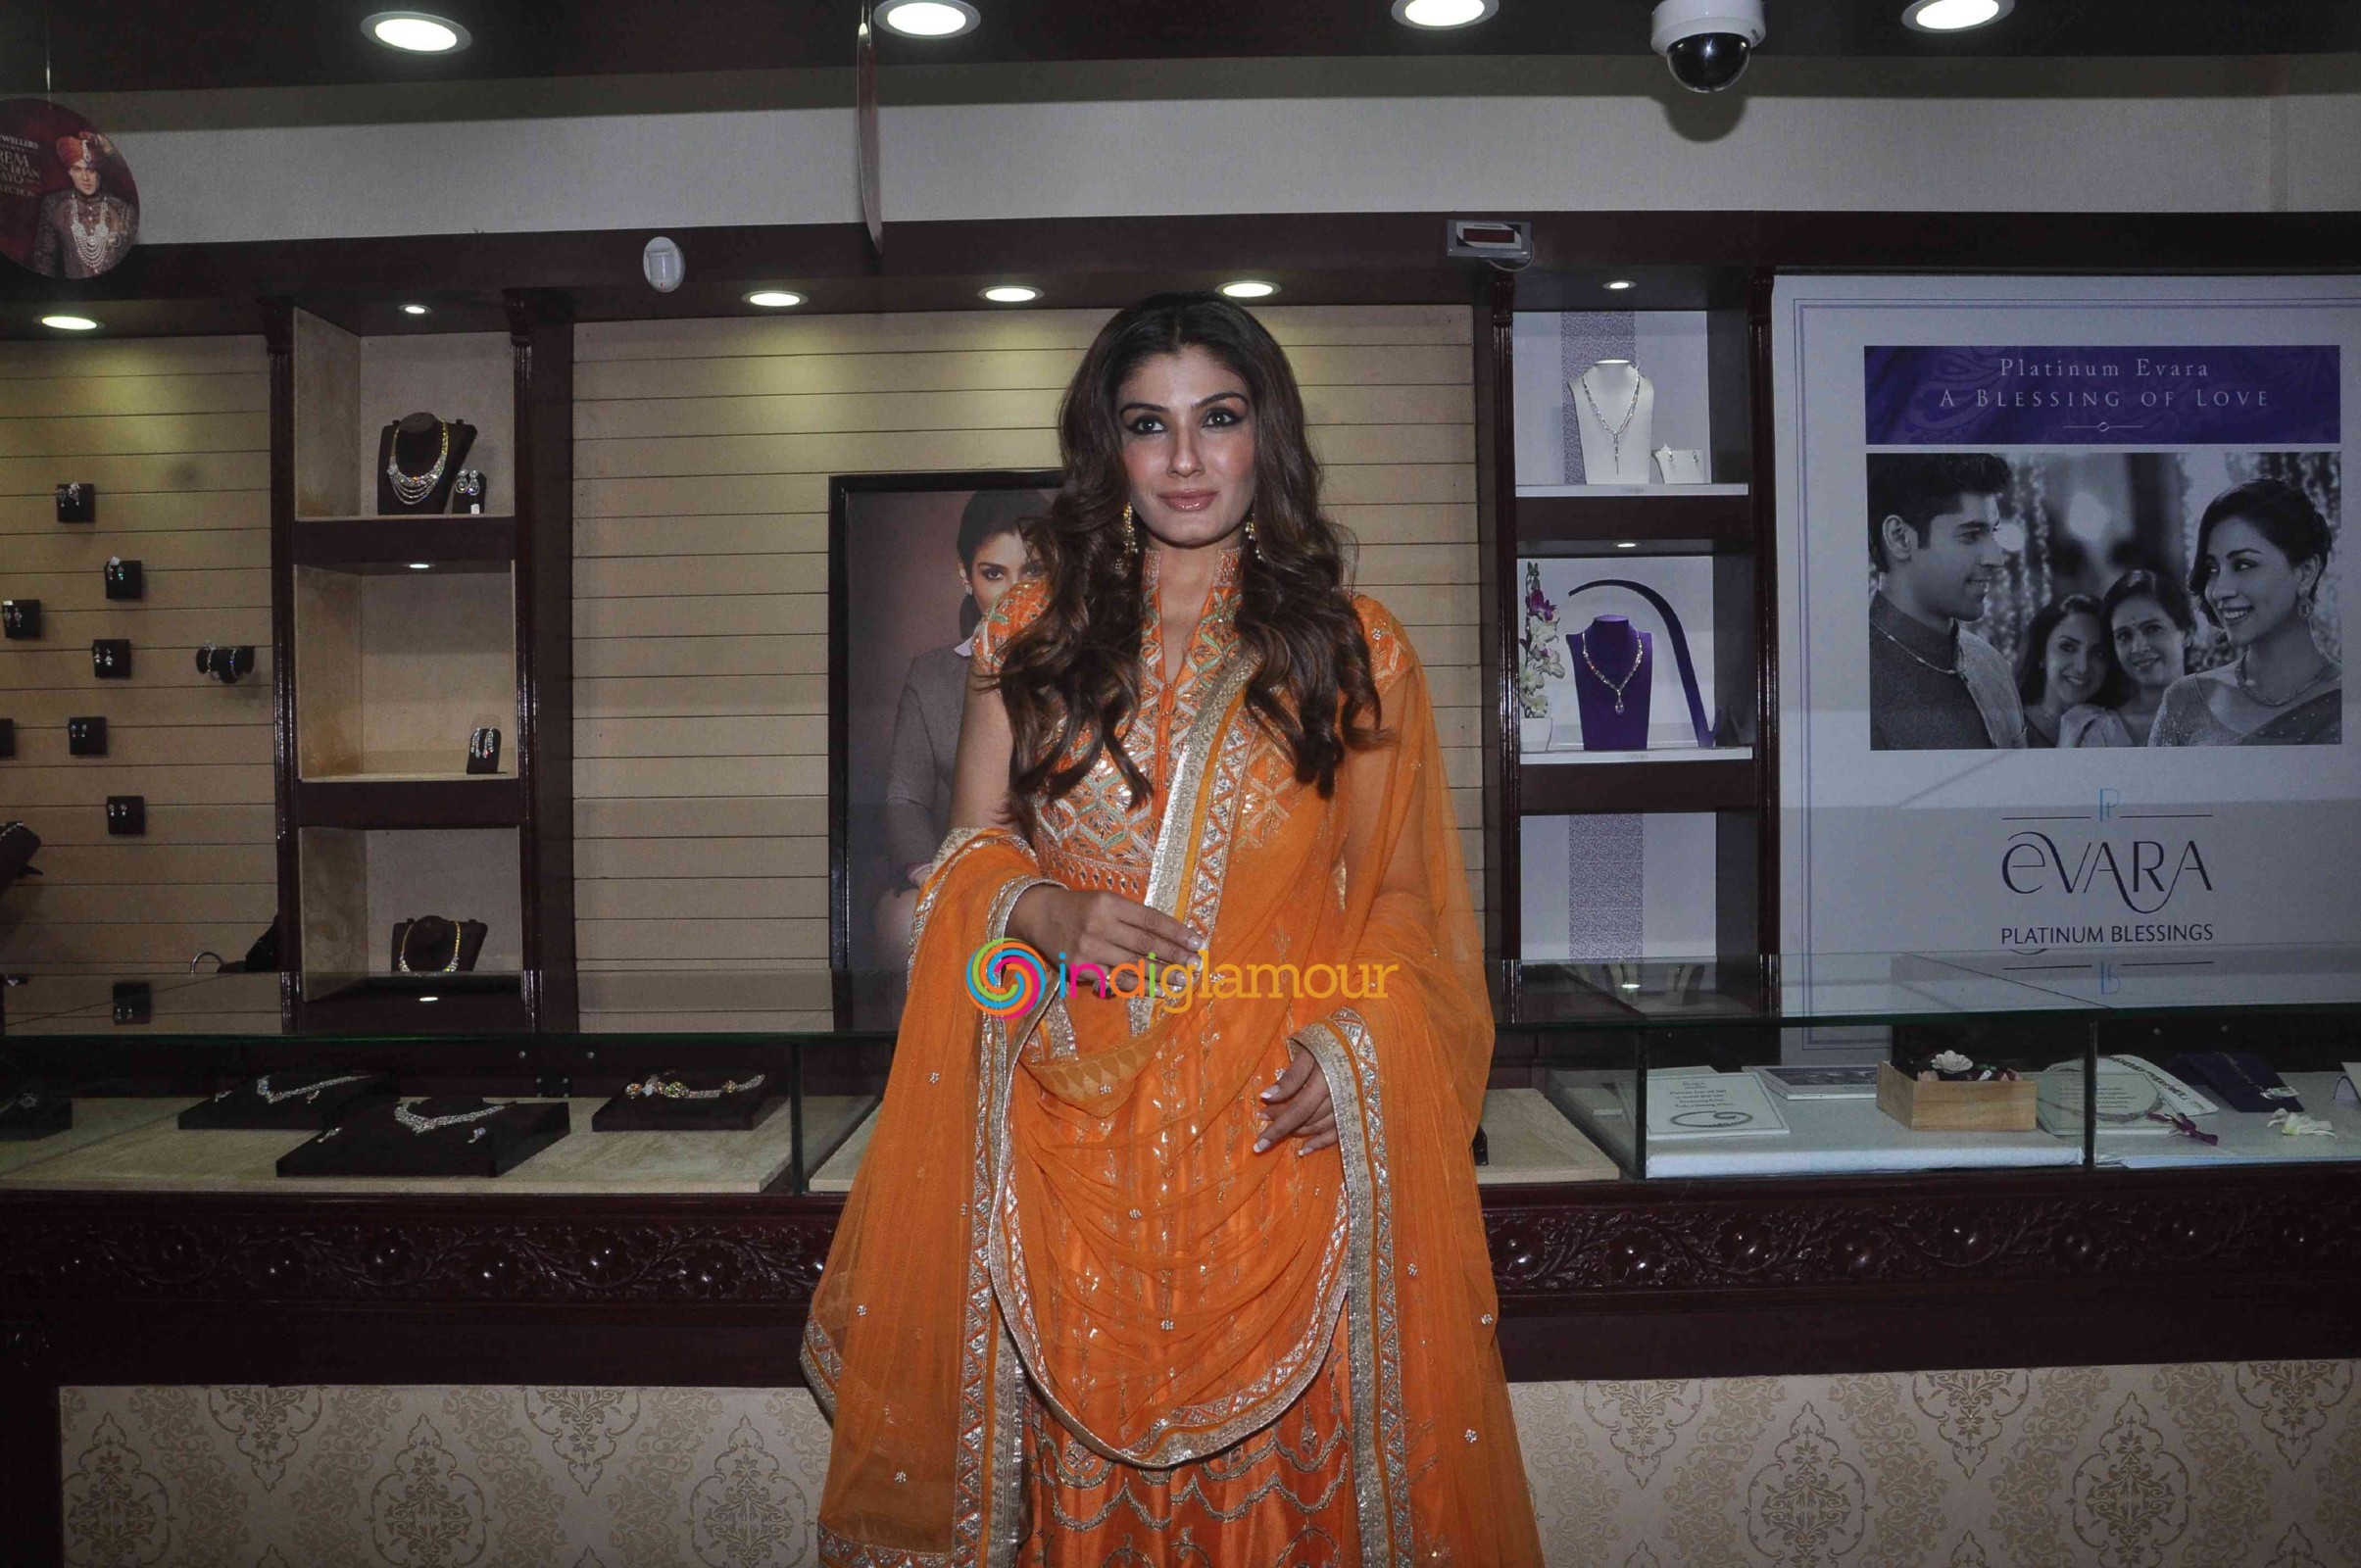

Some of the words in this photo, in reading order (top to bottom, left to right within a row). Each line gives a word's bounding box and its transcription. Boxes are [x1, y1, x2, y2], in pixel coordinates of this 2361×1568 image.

[1999, 358, 2119, 376] Platinum
[2136, 358, 2208, 376] Evara
[1940, 389, 1955, 408] A
[1977, 389, 2119, 408] BLESSING
[2140, 391, 2173, 407] OF
[2196, 388, 2267, 407] LOVE
[2001, 926, 2104, 945] PLATINUM
[2111, 923, 2213, 943] BLESSINGS
